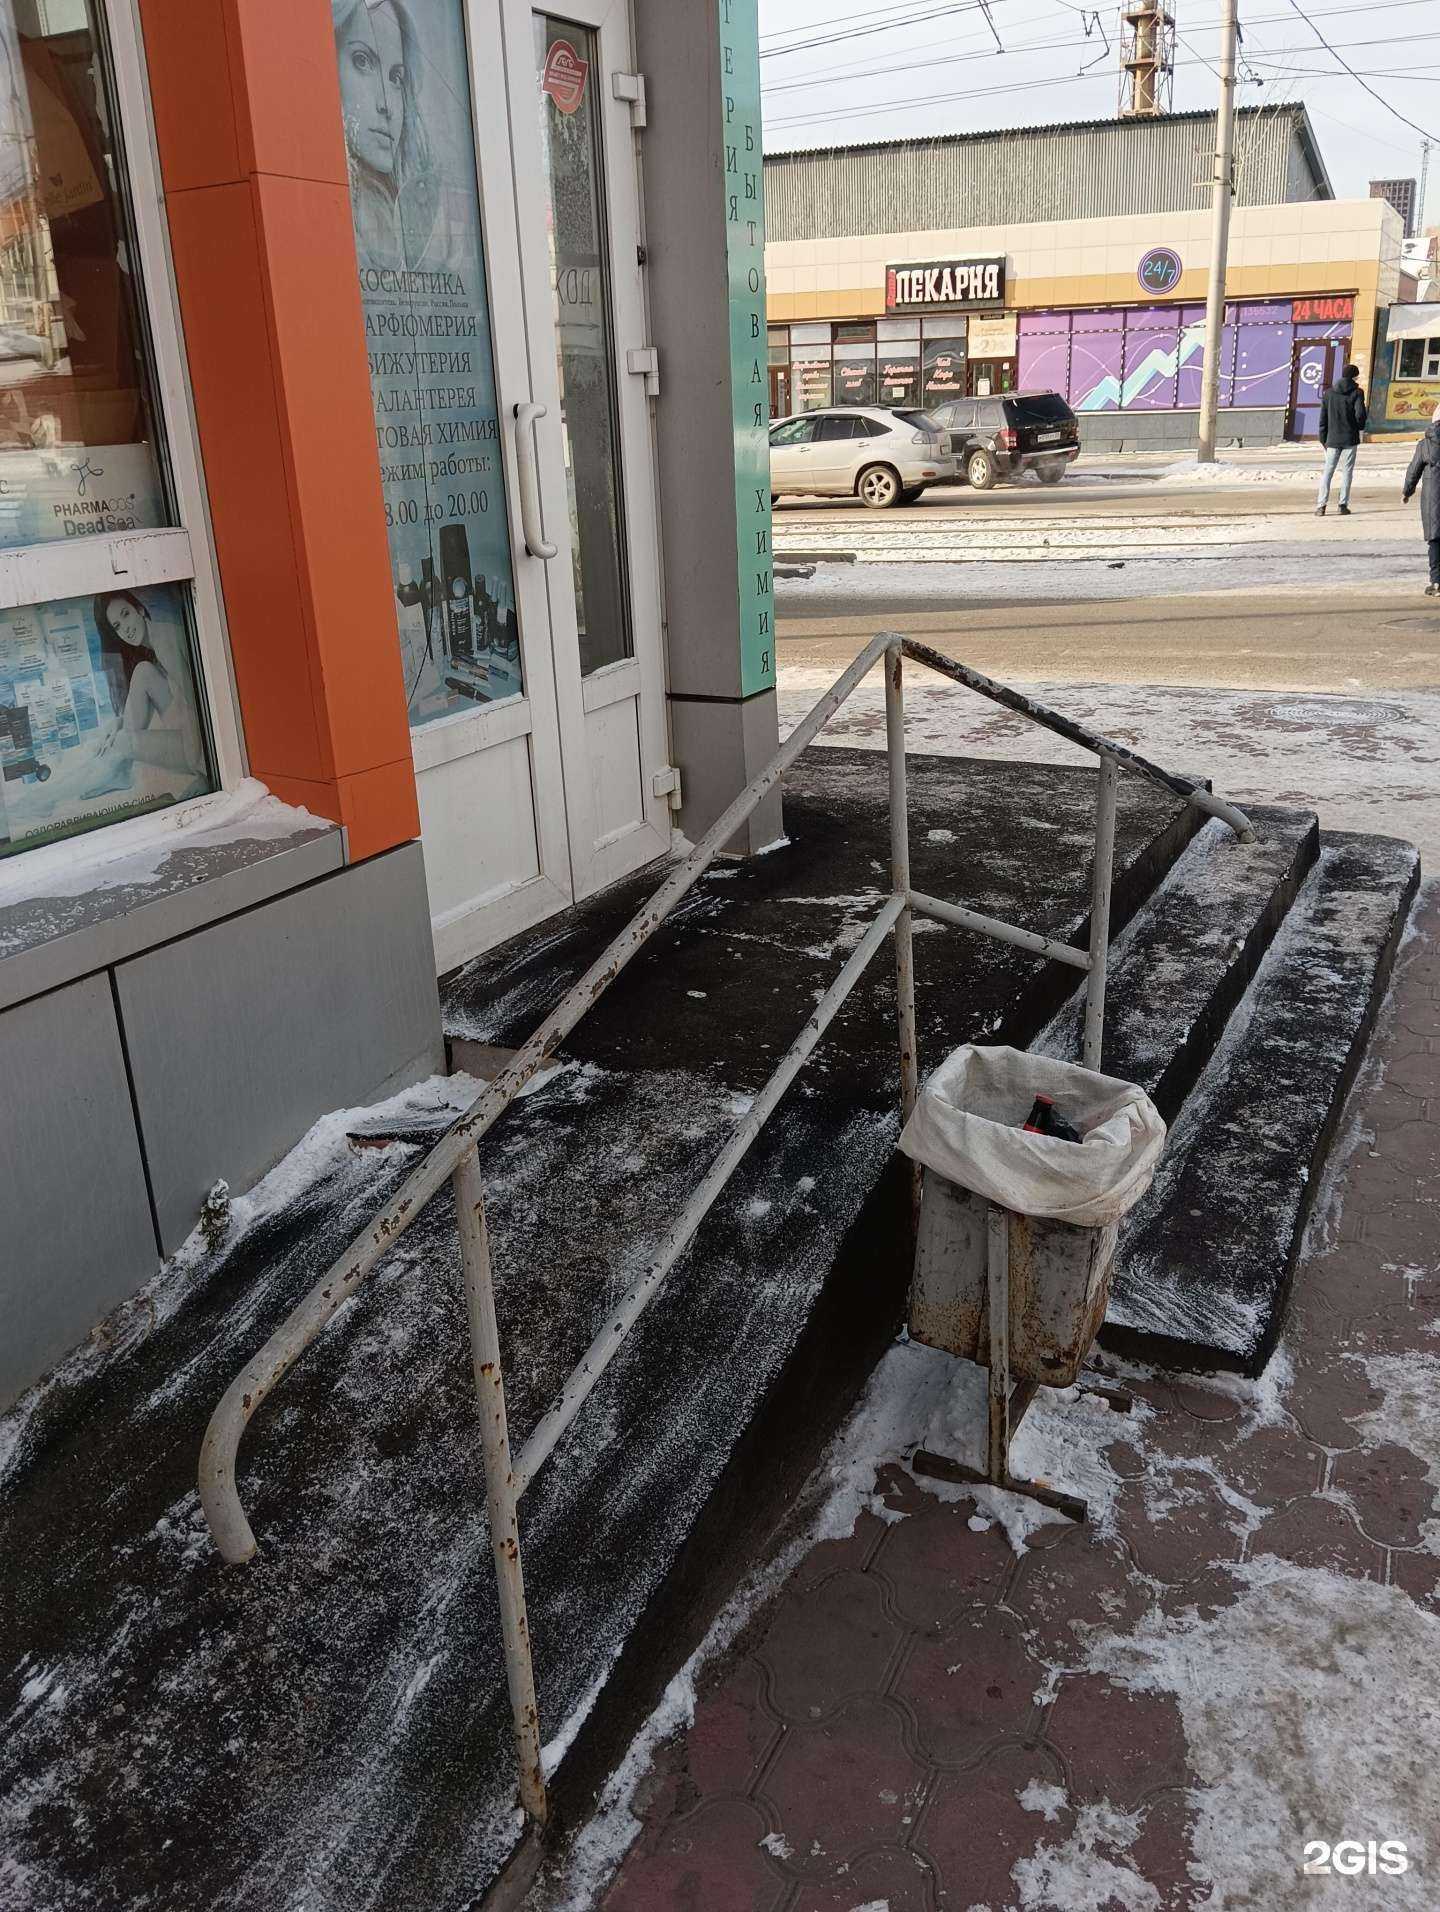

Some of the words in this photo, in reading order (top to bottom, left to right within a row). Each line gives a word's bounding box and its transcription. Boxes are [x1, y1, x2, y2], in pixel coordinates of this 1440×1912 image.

[895, 264, 999, 303] ПЕКАРНЯ
[1144, 260, 1176, 283] 24/7
[365, 312, 477, 337] АРФЮМЕРИЯ
[1293, 300, 1311, 321] 24
[1313, 298, 1353, 320] ЧАСА
[371, 387, 477, 412] АЛАНТЕРЕЯ
[744, 125, 763, 427] БЫТОВАЯ
[755, 489, 769, 674] ХИМИЯ
[376, 423, 434, 449] ТОВАЯ
[437, 419, 497, 444] ХИМИЯ
[379, 462, 425, 483] ежим
[430, 452, 492, 485] работы:
[424, 501, 443, 524] до
[448, 490, 489, 517] 20.00
